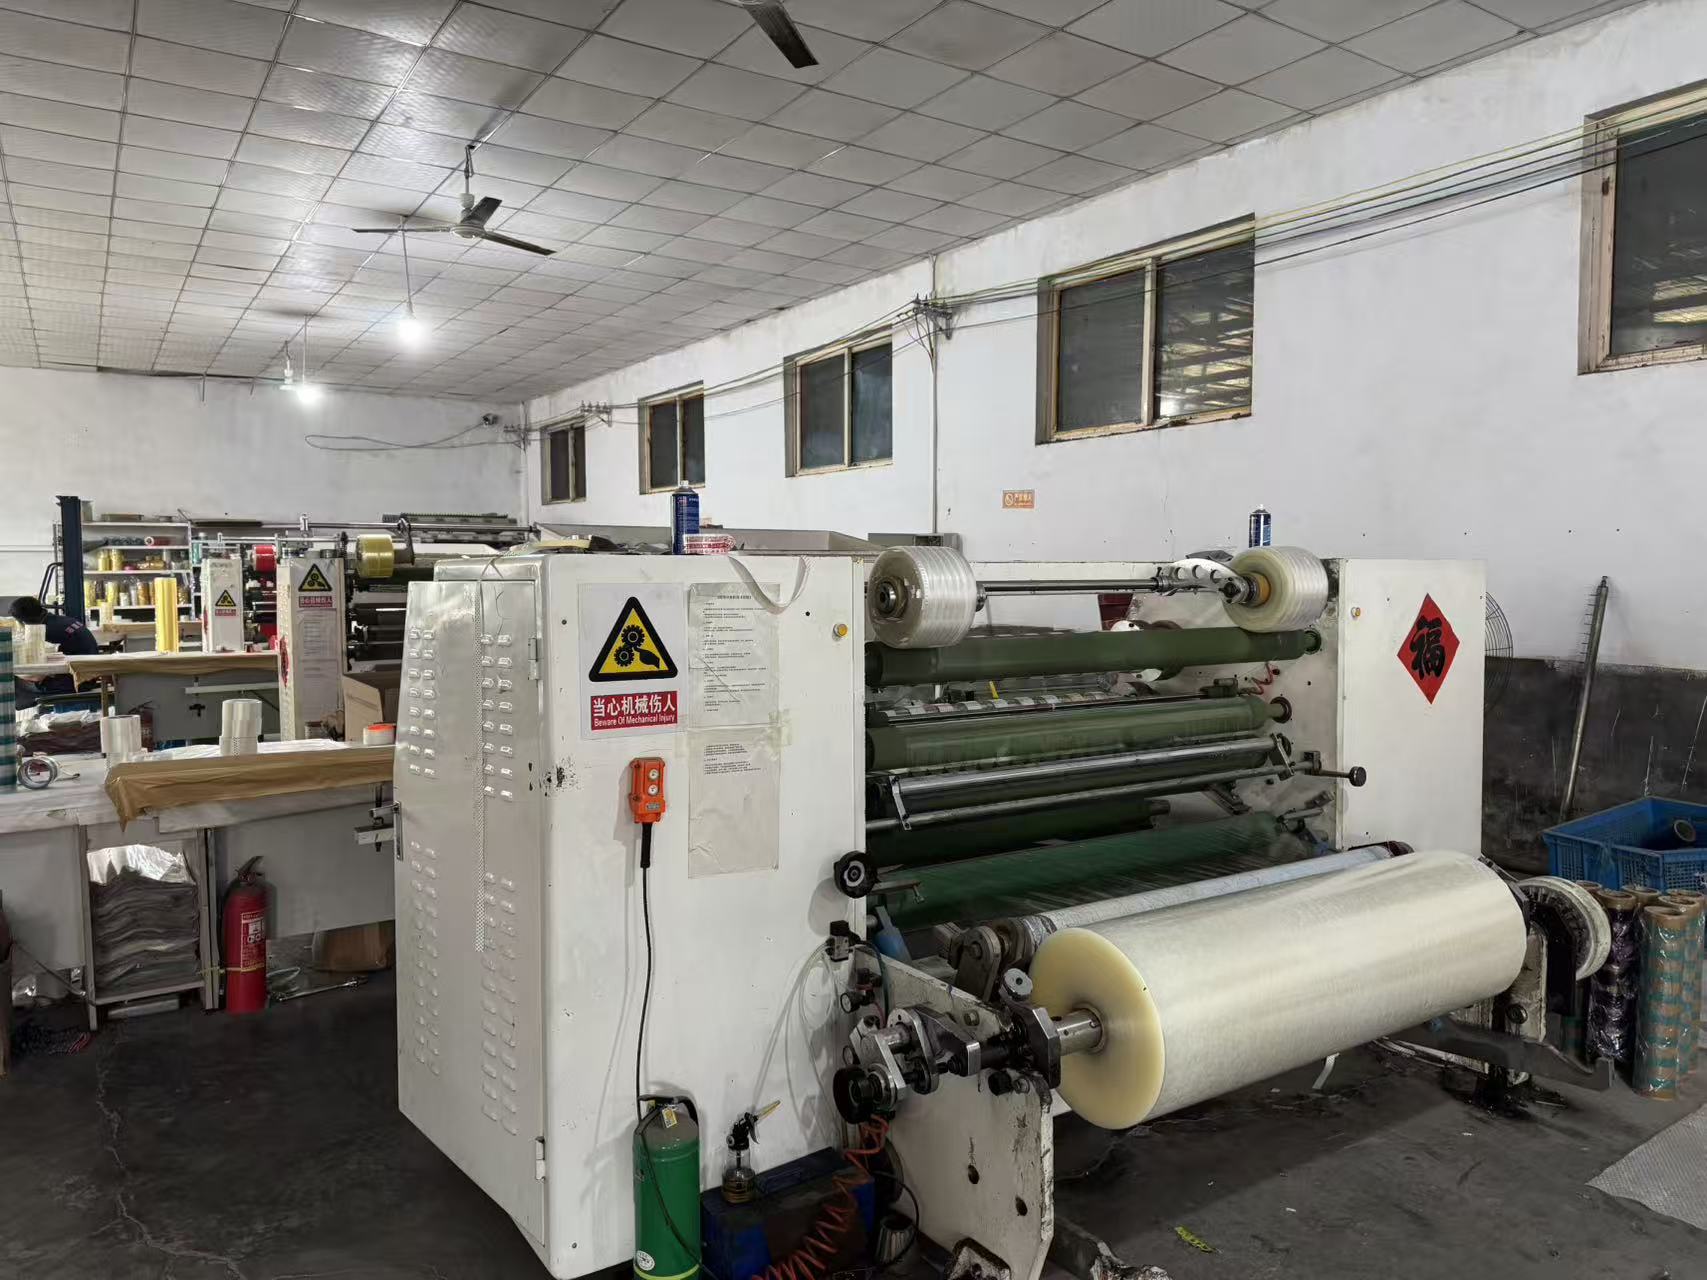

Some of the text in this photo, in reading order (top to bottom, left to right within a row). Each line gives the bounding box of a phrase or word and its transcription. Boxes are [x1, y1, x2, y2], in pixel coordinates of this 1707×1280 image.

[1410, 615, 1446, 680] 福
[593, 694, 675, 717] 当心机械伤人
[594, 713, 675, 727] Beware Of Mechanical Injury
